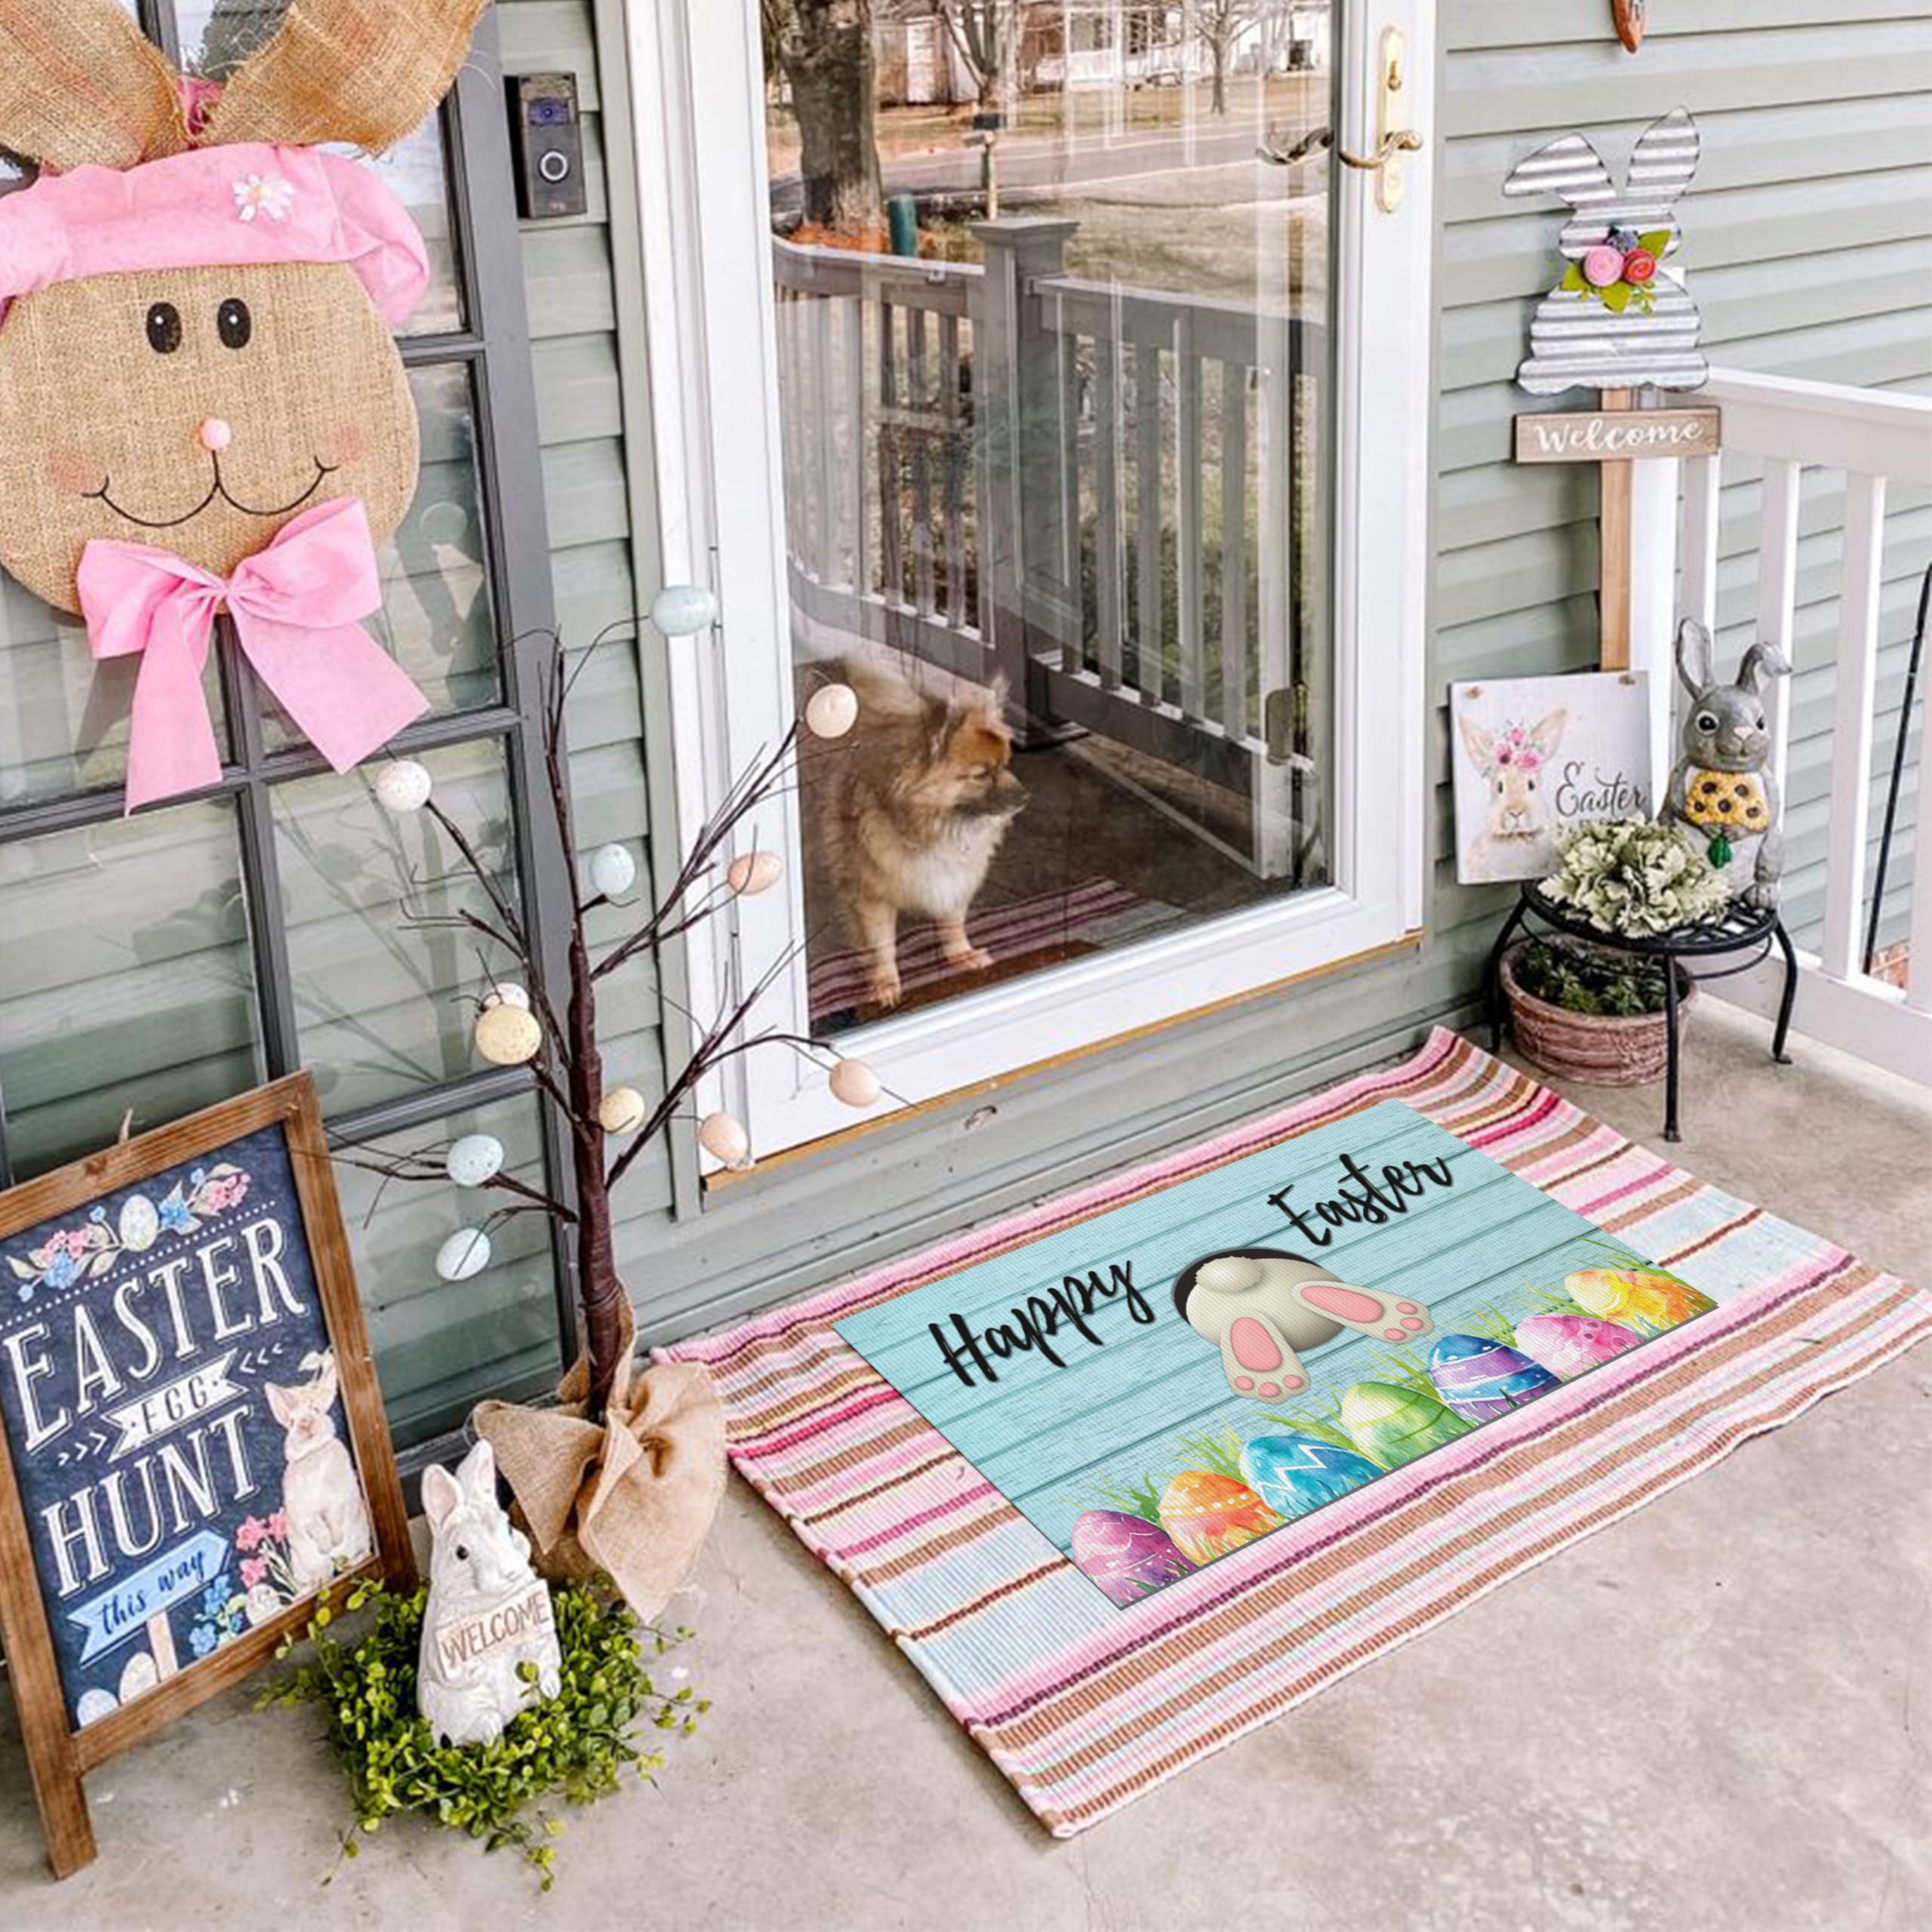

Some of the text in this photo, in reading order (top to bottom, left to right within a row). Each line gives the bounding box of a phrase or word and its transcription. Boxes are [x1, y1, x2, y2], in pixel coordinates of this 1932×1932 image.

[1534, 419, 1703, 453] Welcome
[1556, 761, 1647, 817] Easter
[928, 1153, 1454, 1387] Happy Easter
[3, 1217, 306, 1452] EASTER
[141, 1375, 208, 1435] EGG
[41, 1405, 260, 1598] HUNT
[102, 1550, 205, 1635] this way
[442, 1591, 549, 1667] WELCOME
